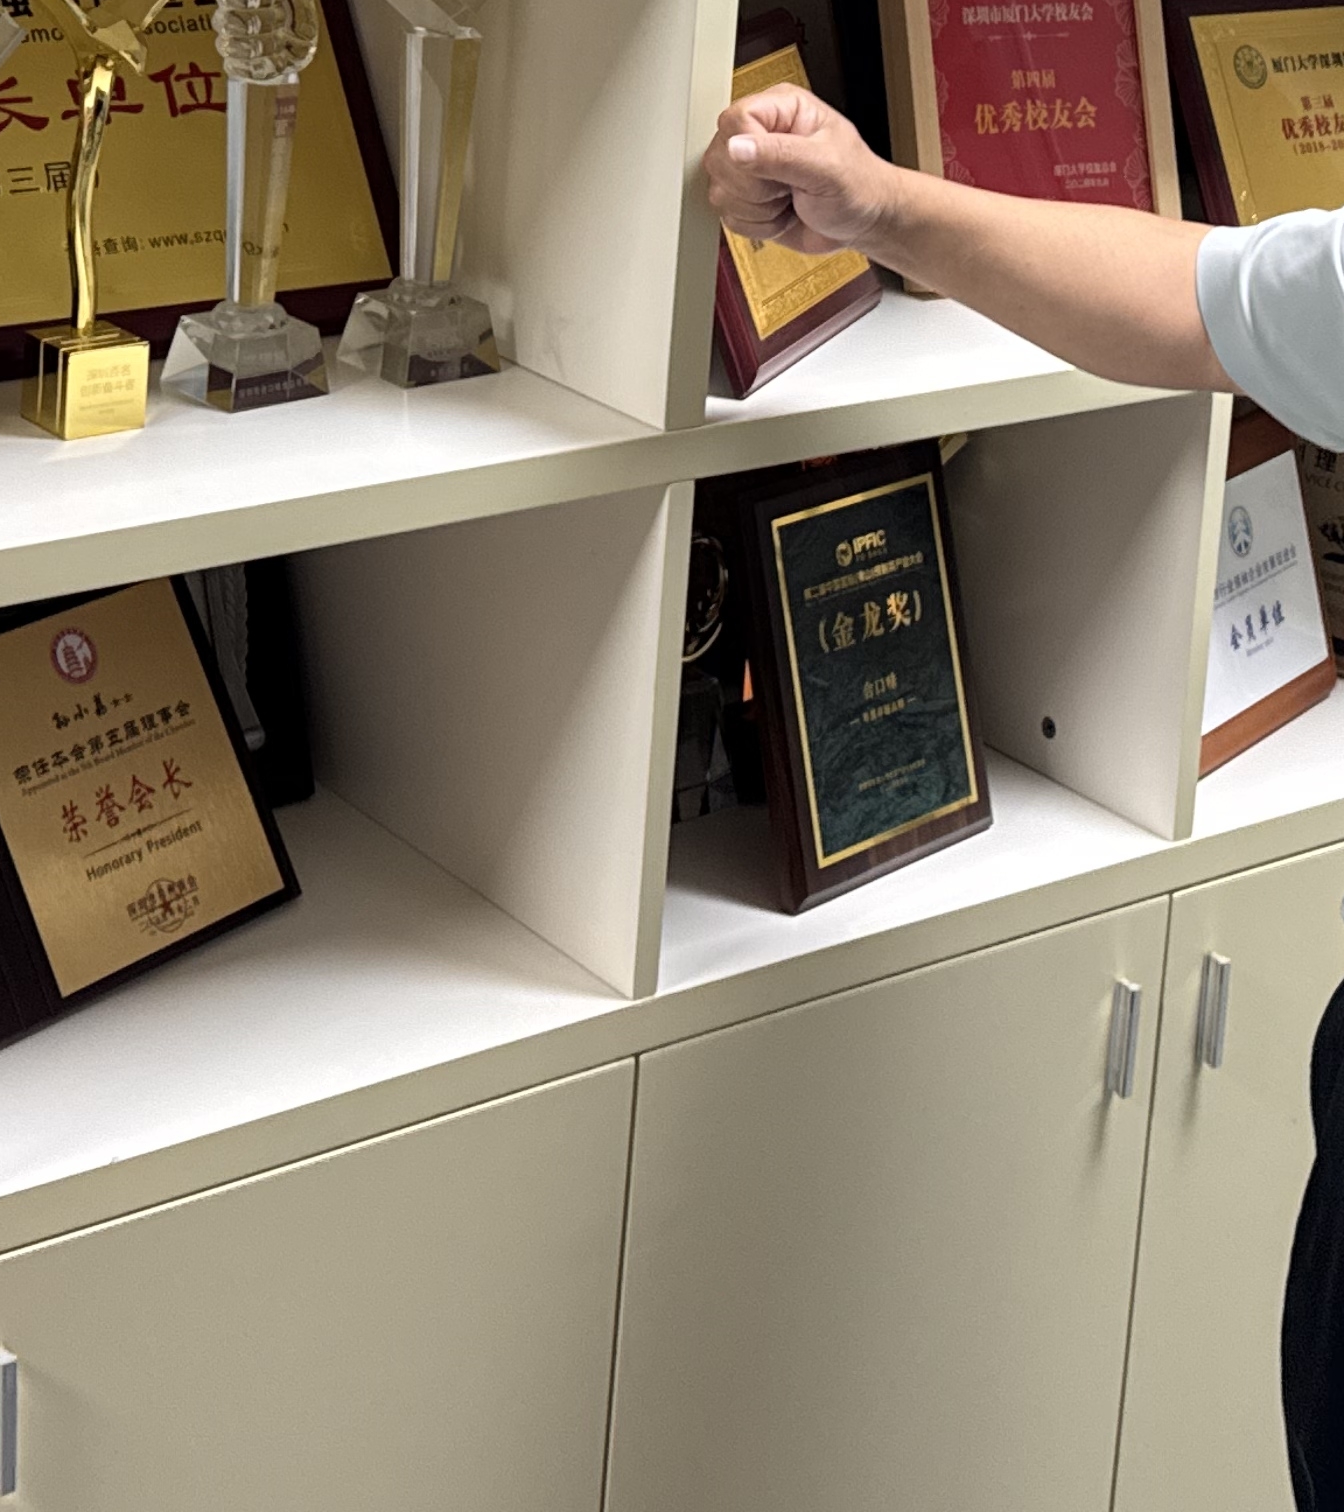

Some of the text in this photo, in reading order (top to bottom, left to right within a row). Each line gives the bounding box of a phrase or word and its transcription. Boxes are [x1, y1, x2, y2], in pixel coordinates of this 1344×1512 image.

[1010, 68, 1056, 91] 第四届
[974, 97, 1099, 136] 优秀校友会
[60, 757, 194, 844] 荣誉会长
[85, 818, 204, 882] Honorary President
